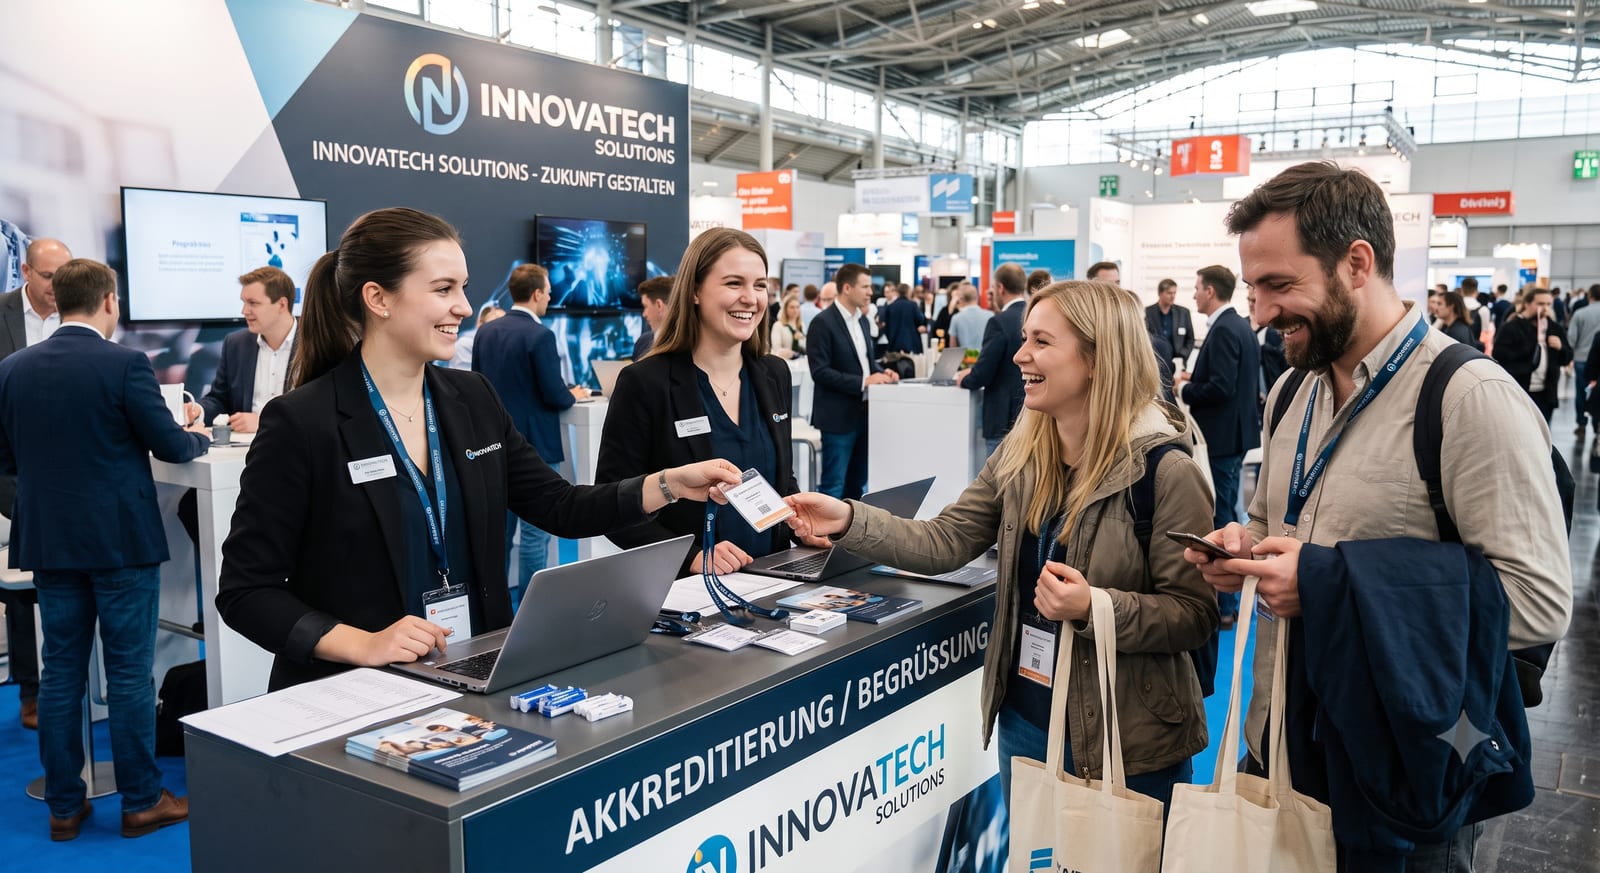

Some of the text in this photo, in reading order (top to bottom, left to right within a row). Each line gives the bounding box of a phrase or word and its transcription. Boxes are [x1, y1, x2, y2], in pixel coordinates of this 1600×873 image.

[480, 82, 675, 144] INNOVATECH
[312, 140, 435, 172] INNOVATECH
[438, 154, 529, 182] SOLUTIONS
[540, 166, 606, 188] ZUKUNFT
[606, 173, 675, 196] GESTALTEN
[594, 139, 675, 165] SOLUTIONS
[1391, 211, 1421, 222] ECH
[565, 694, 834, 855] AKKREDITIERUNG
[839, 679, 852, 726] /
[858, 621, 988, 710] BEGRÜSSUNG
[748, 723, 945, 873] INNOVATECH
[875, 768, 945, 825] SOLUTIONS
